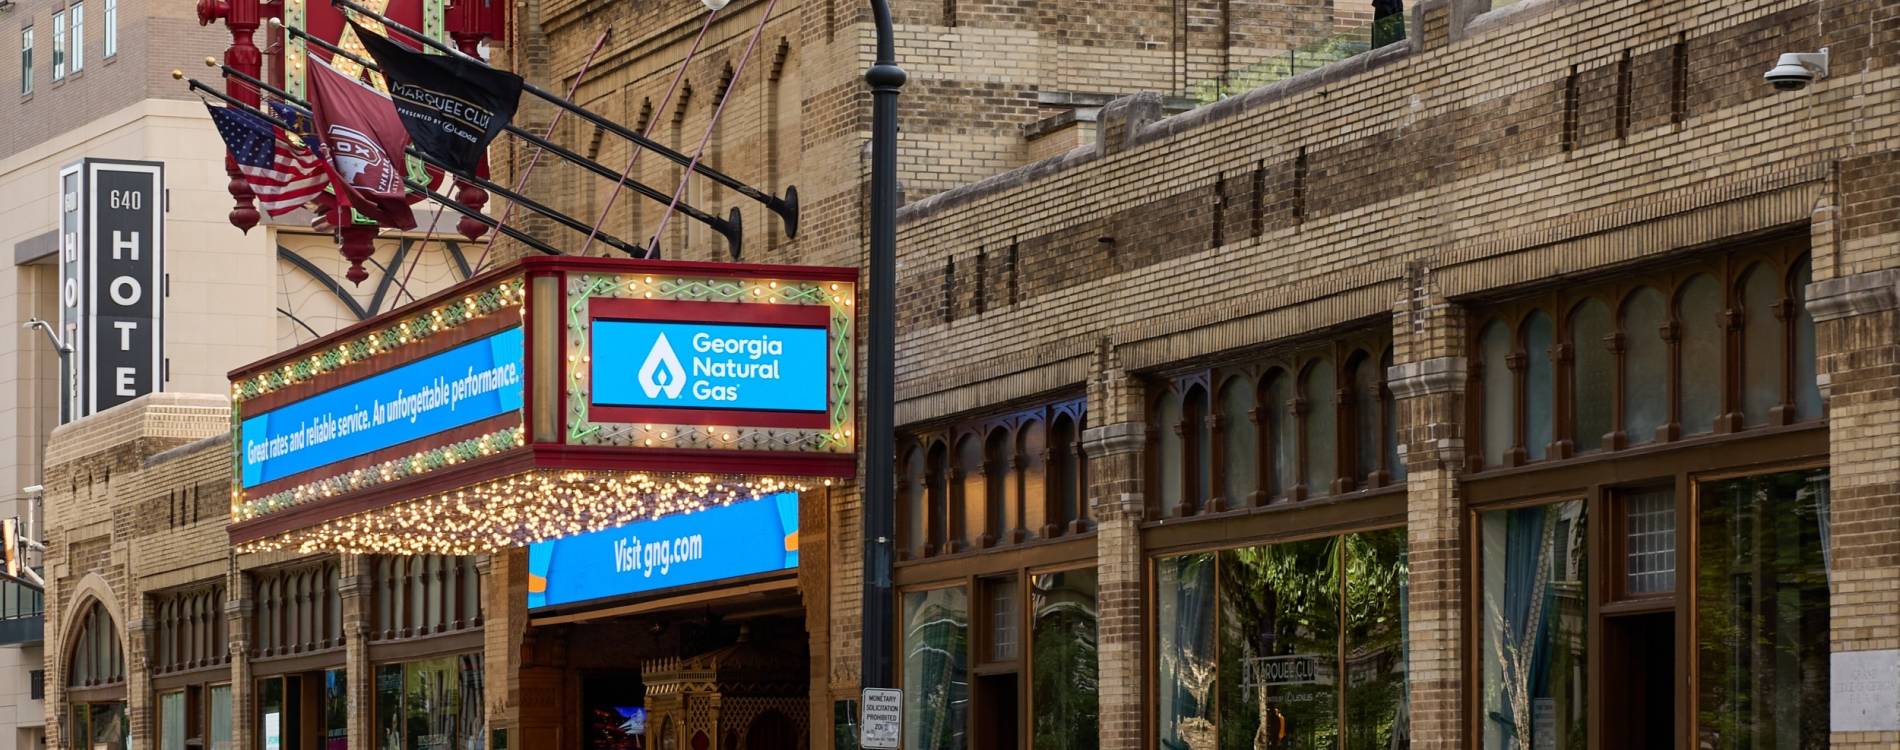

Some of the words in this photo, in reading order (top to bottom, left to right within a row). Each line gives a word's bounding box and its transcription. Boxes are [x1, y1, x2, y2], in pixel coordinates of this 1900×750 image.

[392, 81, 463, 117] MARQUEE
[397, 107, 432, 122] PRESENTED
[433, 118, 442, 126] BY
[110, 189, 142, 210] 640
[109, 230, 142, 397] HOTE
[692, 332, 783, 360] Georgia
[692, 356, 781, 380] Natural
[692, 380, 738, 401] Gas
[247, 438, 269, 465] Great
[269, 433, 289, 462] rates
[289, 421, 305, 452] and
[306, 413, 337, 447] reliable
[337, 403, 371, 438] service.
[372, 399, 386, 427] An
[386, 375, 450, 424] unforgettable
[451, 362, 520, 412] performance.
[614, 535, 642, 573] Visit
[643, 533, 703, 578] gng.com
[866, 704, 899, 712] SOLICITATION
